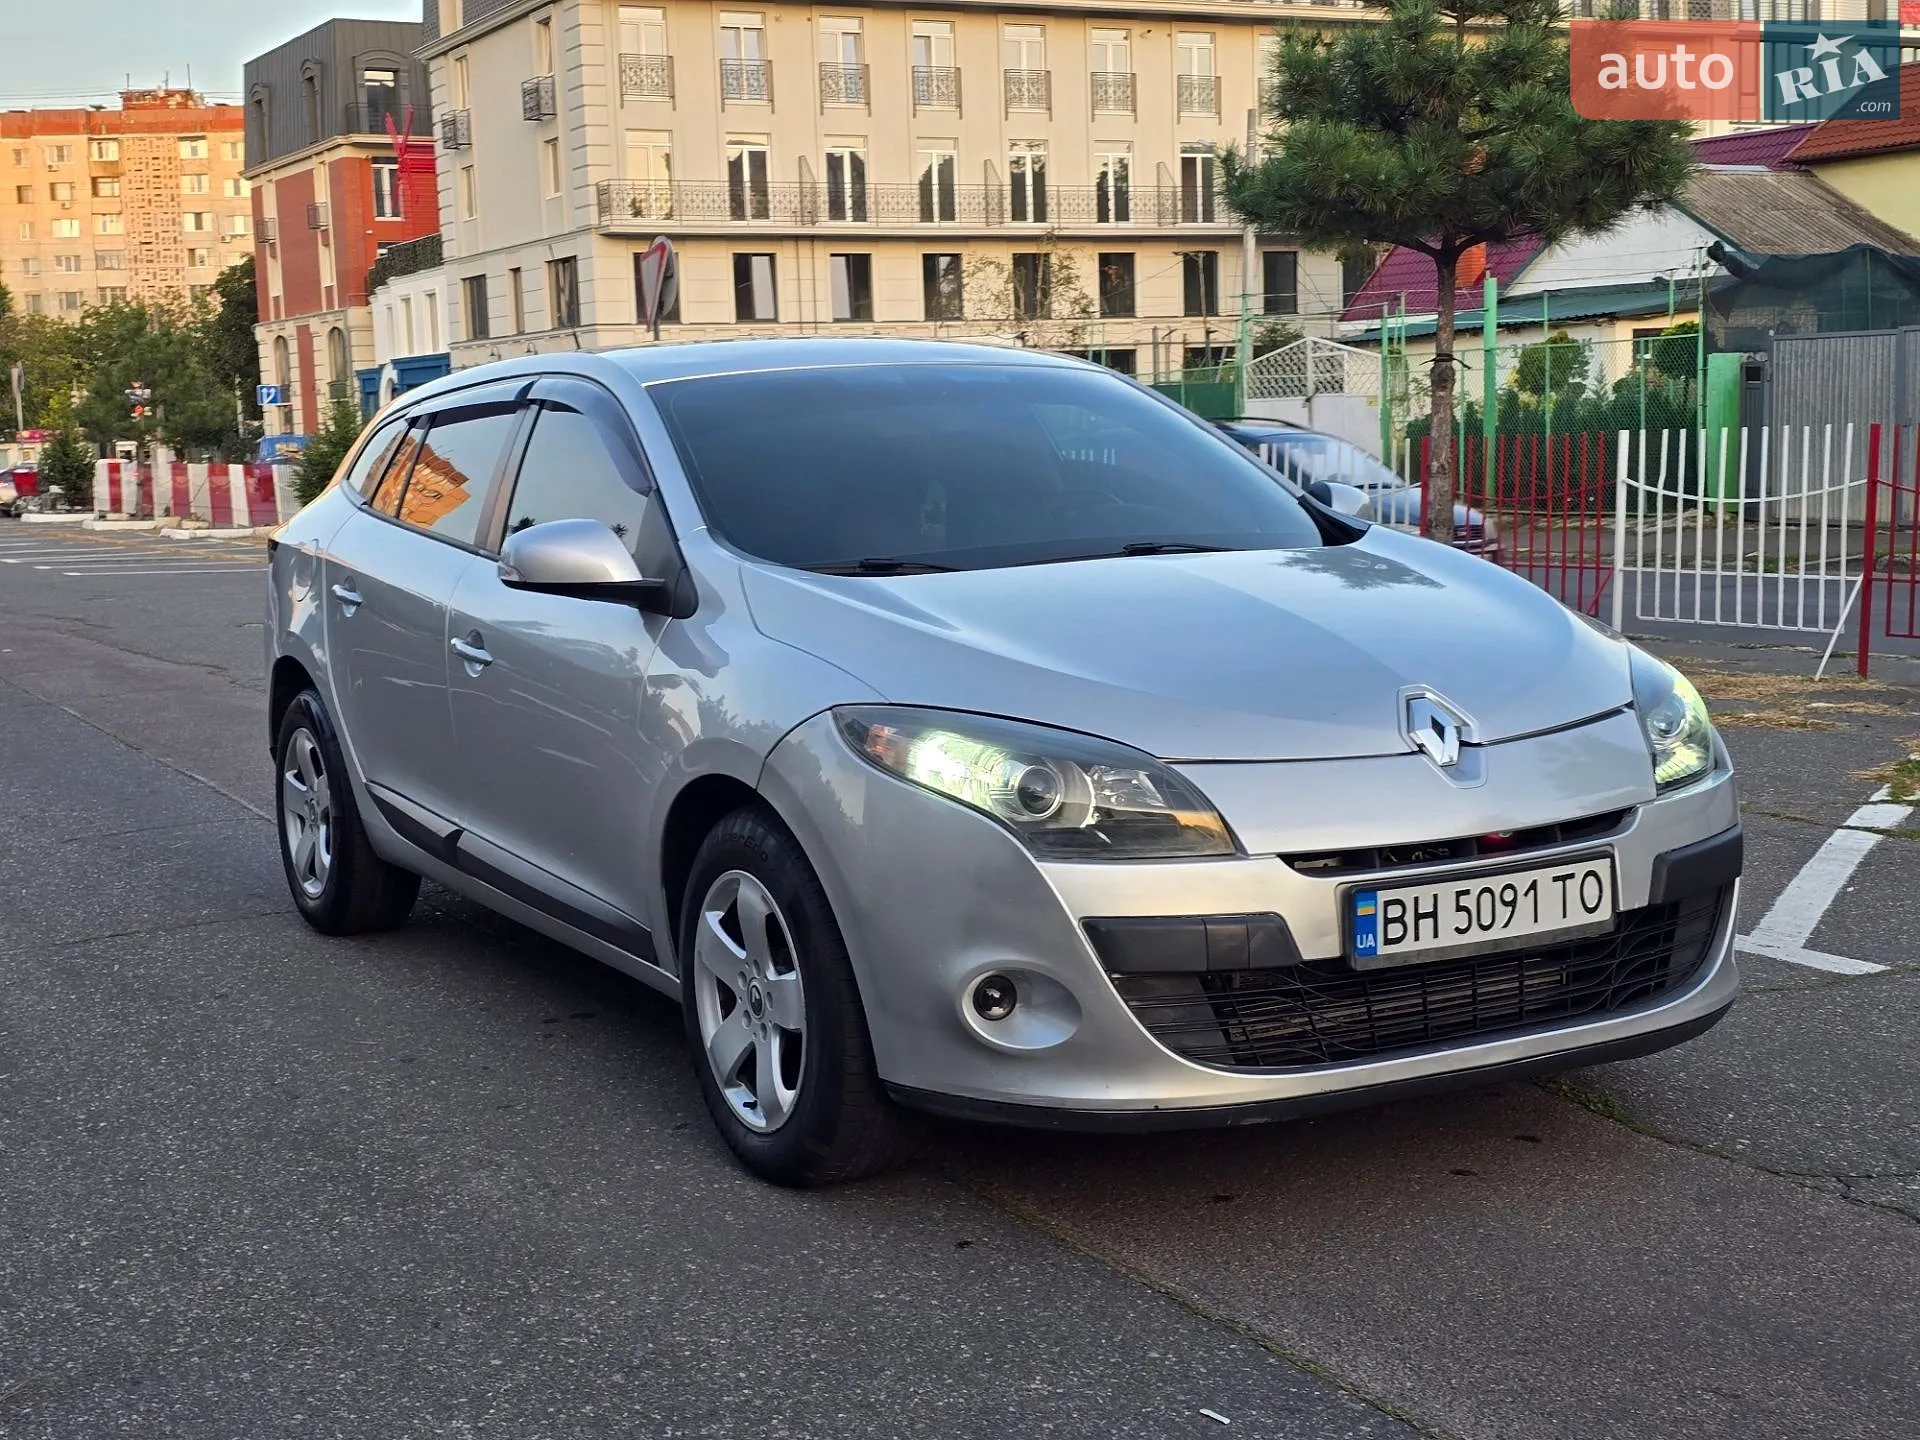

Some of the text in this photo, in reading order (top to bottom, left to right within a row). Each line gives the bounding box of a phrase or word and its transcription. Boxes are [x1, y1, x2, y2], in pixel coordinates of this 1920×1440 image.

[1382, 869, 1603, 946] BH 5091 TO
[1356, 933, 1375, 949] UA
